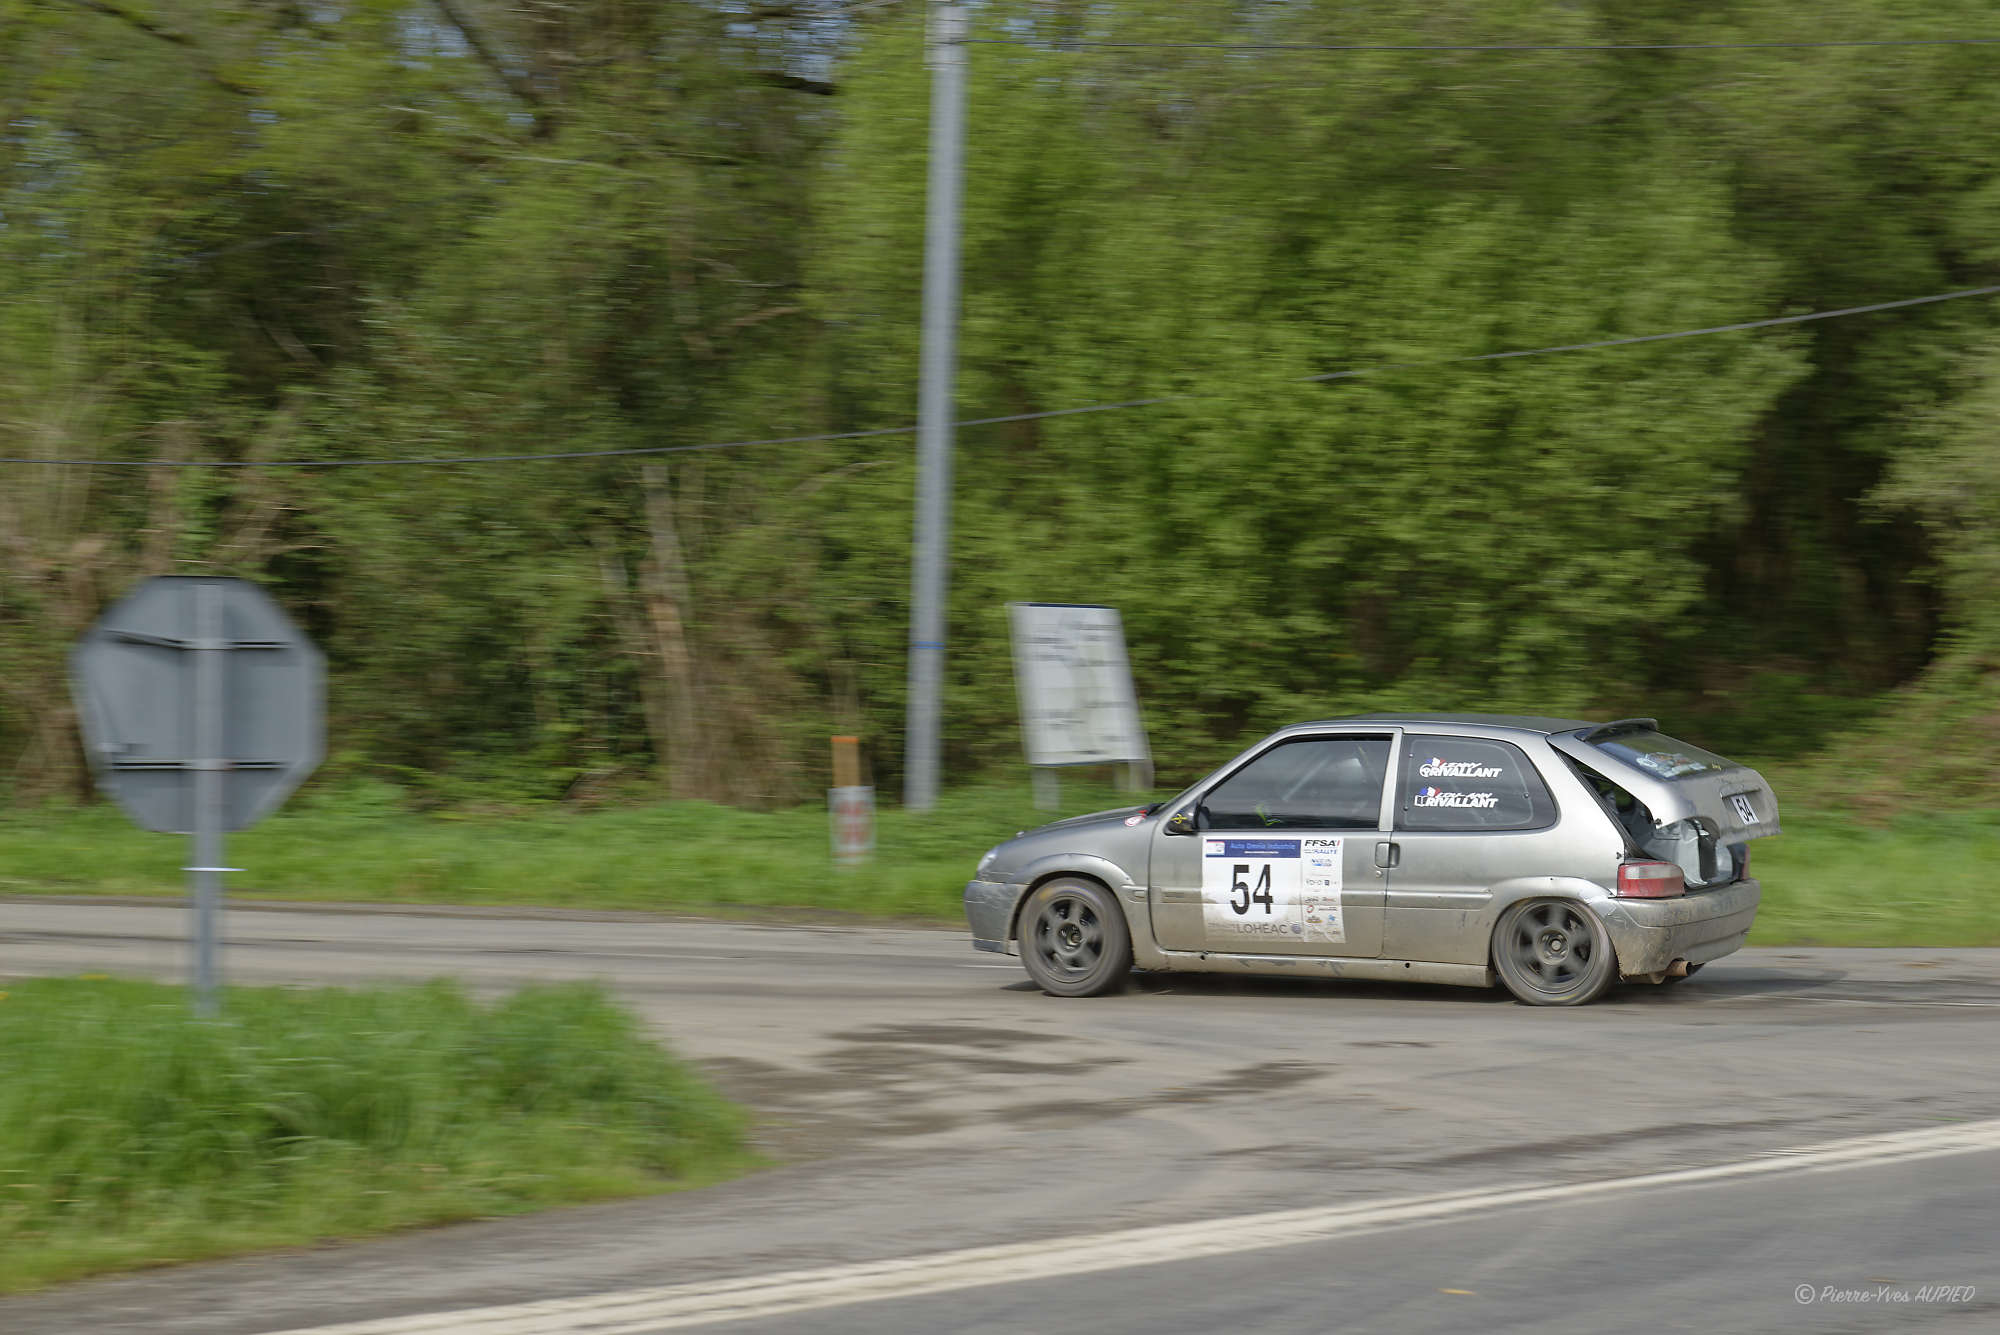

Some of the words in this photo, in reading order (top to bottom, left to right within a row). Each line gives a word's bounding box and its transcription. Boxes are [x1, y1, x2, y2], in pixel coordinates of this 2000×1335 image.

[1429, 766, 1502, 777] RIVALLANT
[1425, 797, 1499, 808] RIVALLANT
[1735, 798, 1755, 822] 54
[1304, 839, 1336, 847] FFSA
[1230, 864, 1273, 915] 54
